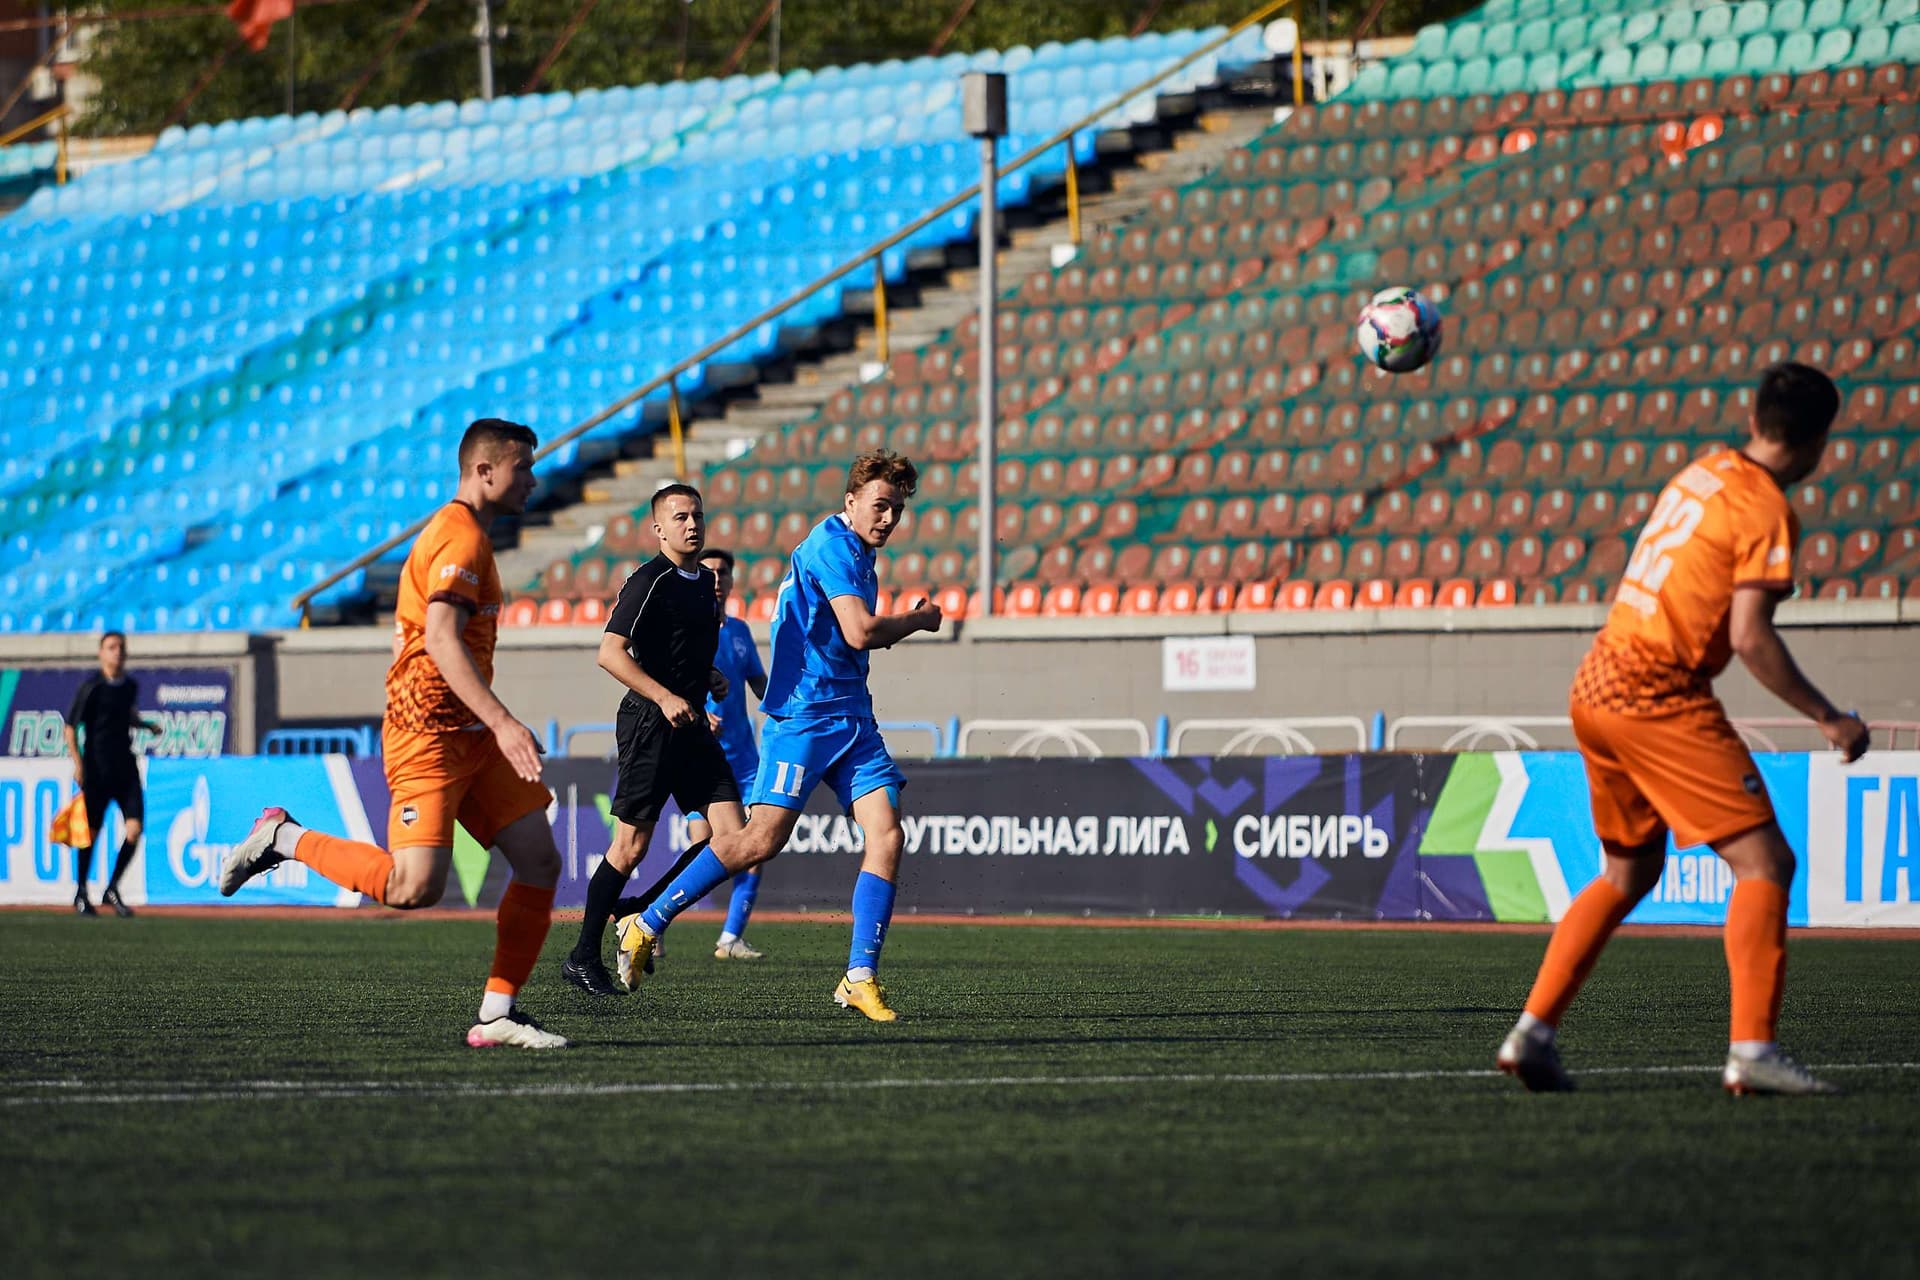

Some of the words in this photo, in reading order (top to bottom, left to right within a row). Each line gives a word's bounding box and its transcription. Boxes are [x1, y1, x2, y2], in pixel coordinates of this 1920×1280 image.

[1625, 486, 1704, 592] 22
[770, 761, 805, 796] 11
[1104, 817, 1190, 855] ЛИГА
[1233, 815, 1389, 858] СИБИРЬ
